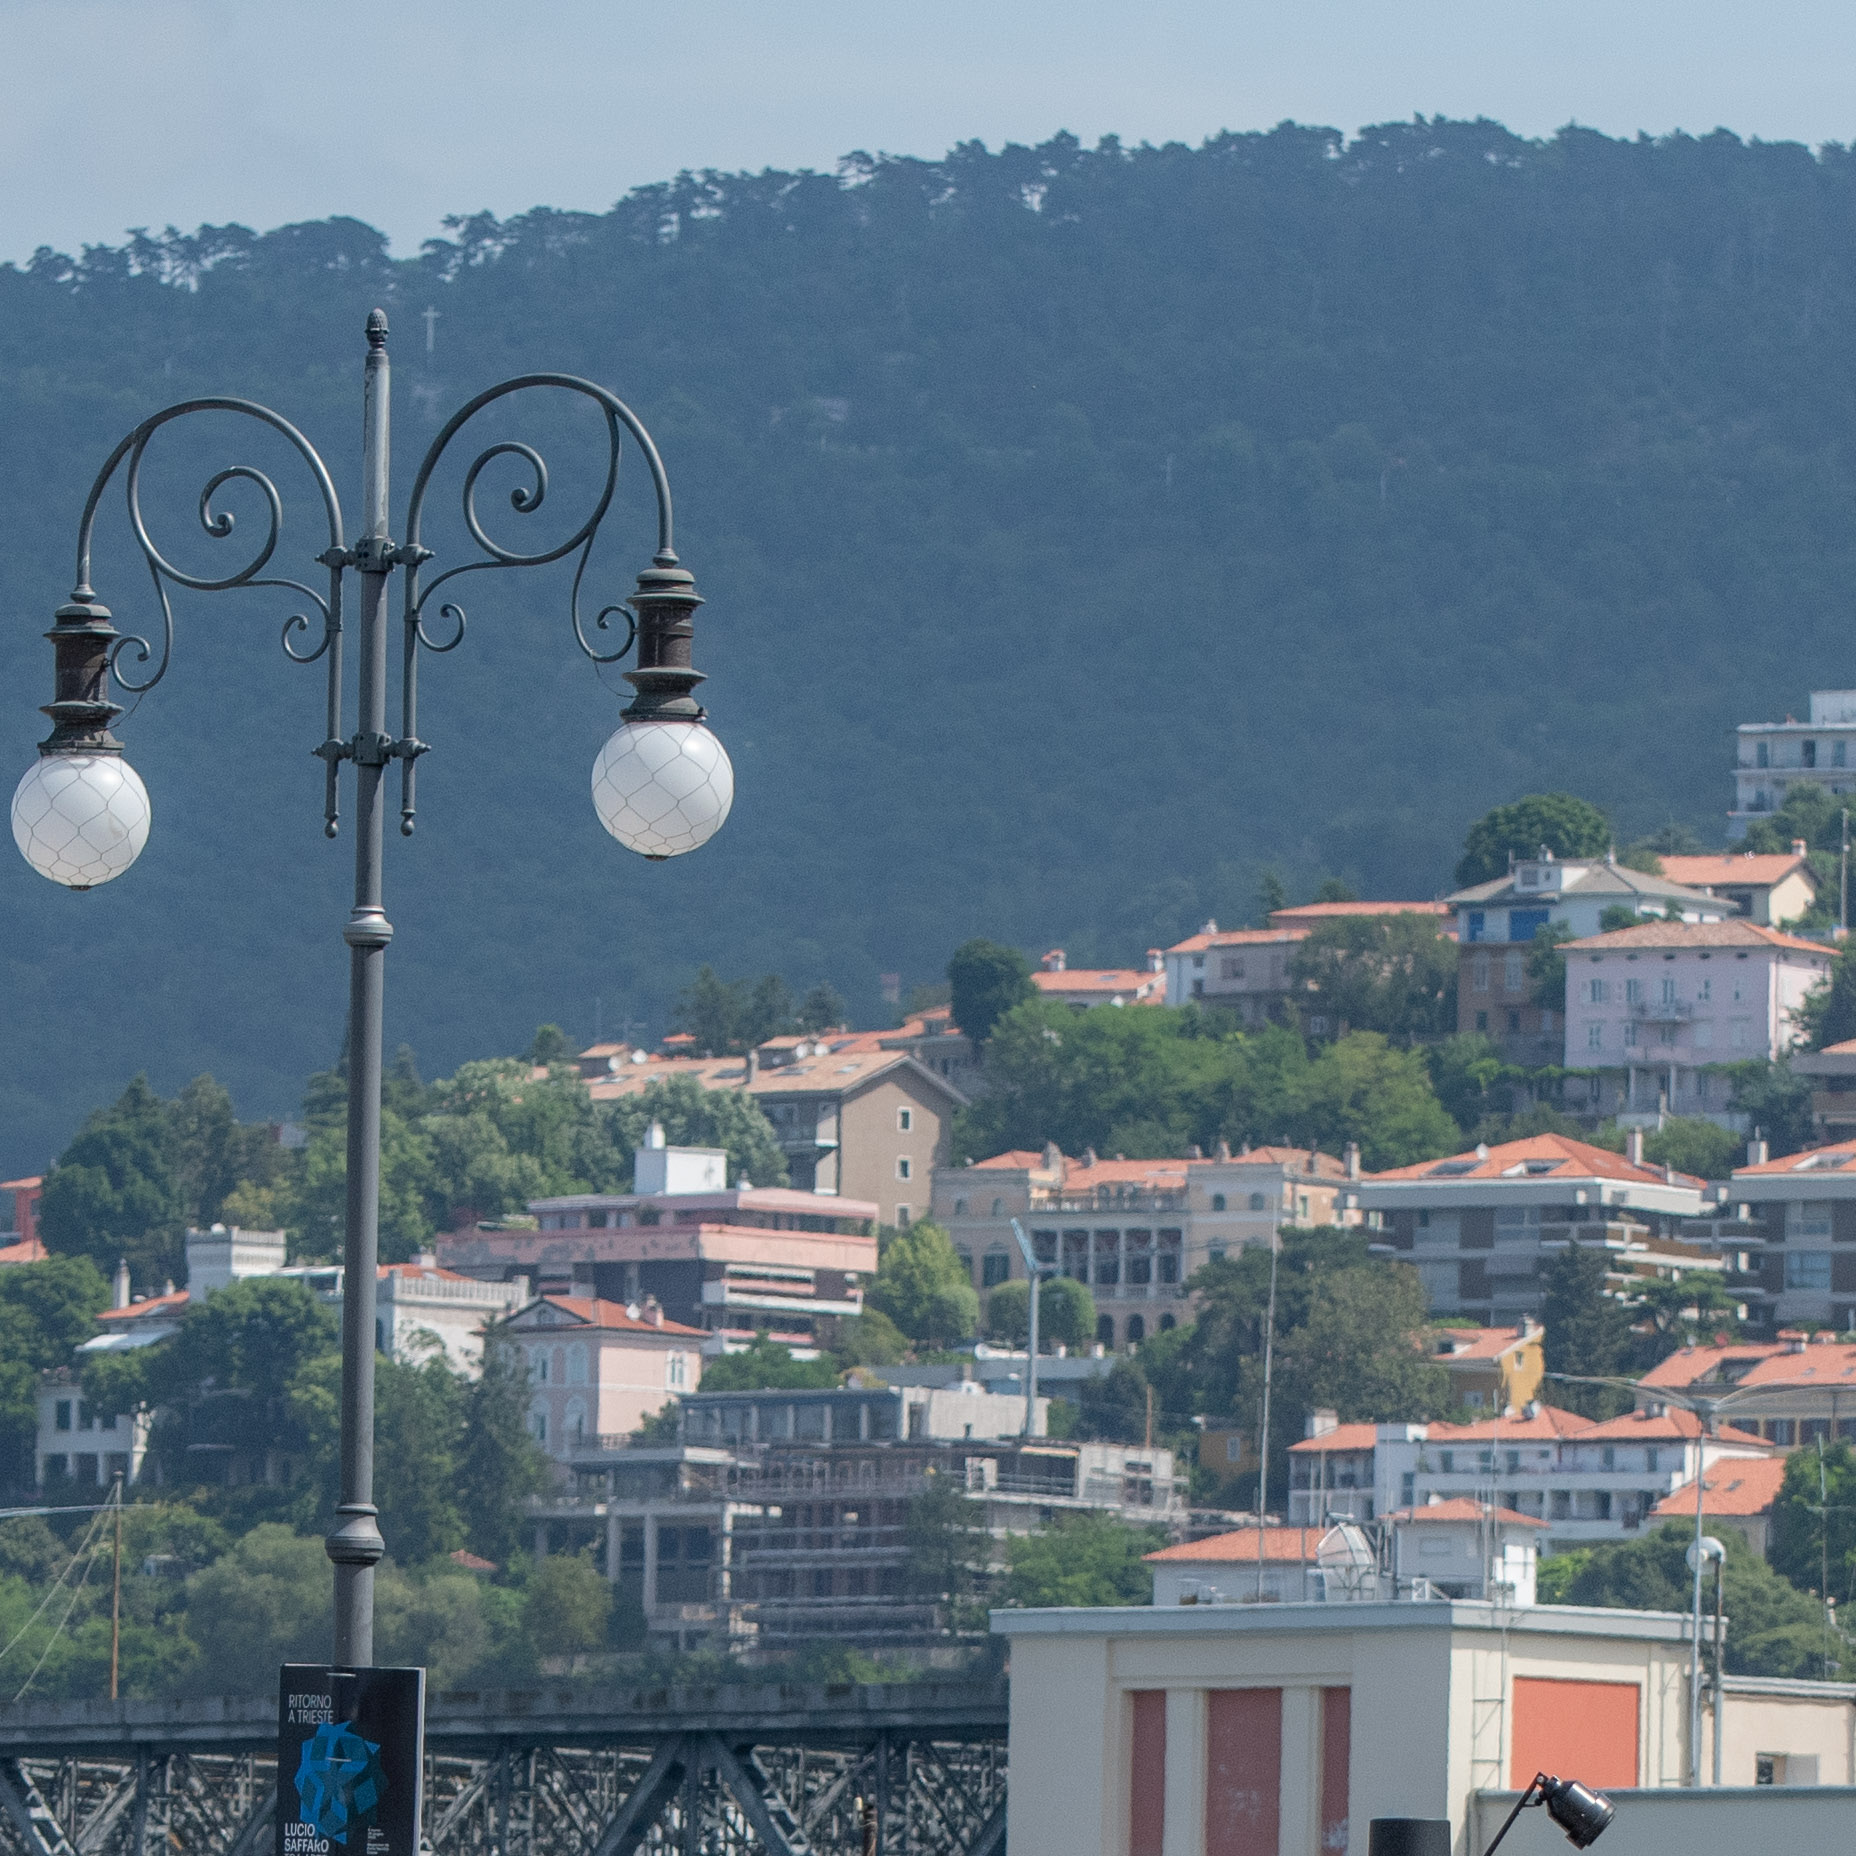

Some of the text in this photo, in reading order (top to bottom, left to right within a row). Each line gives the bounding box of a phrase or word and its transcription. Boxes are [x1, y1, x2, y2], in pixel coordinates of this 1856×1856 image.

[288, 1694, 332, 1708] RITORNO
[288, 1710, 334, 1724] A TRIESTE
[284, 1823, 316, 1837] LUCIO
[284, 1838, 329, 1852] SAFFARO
